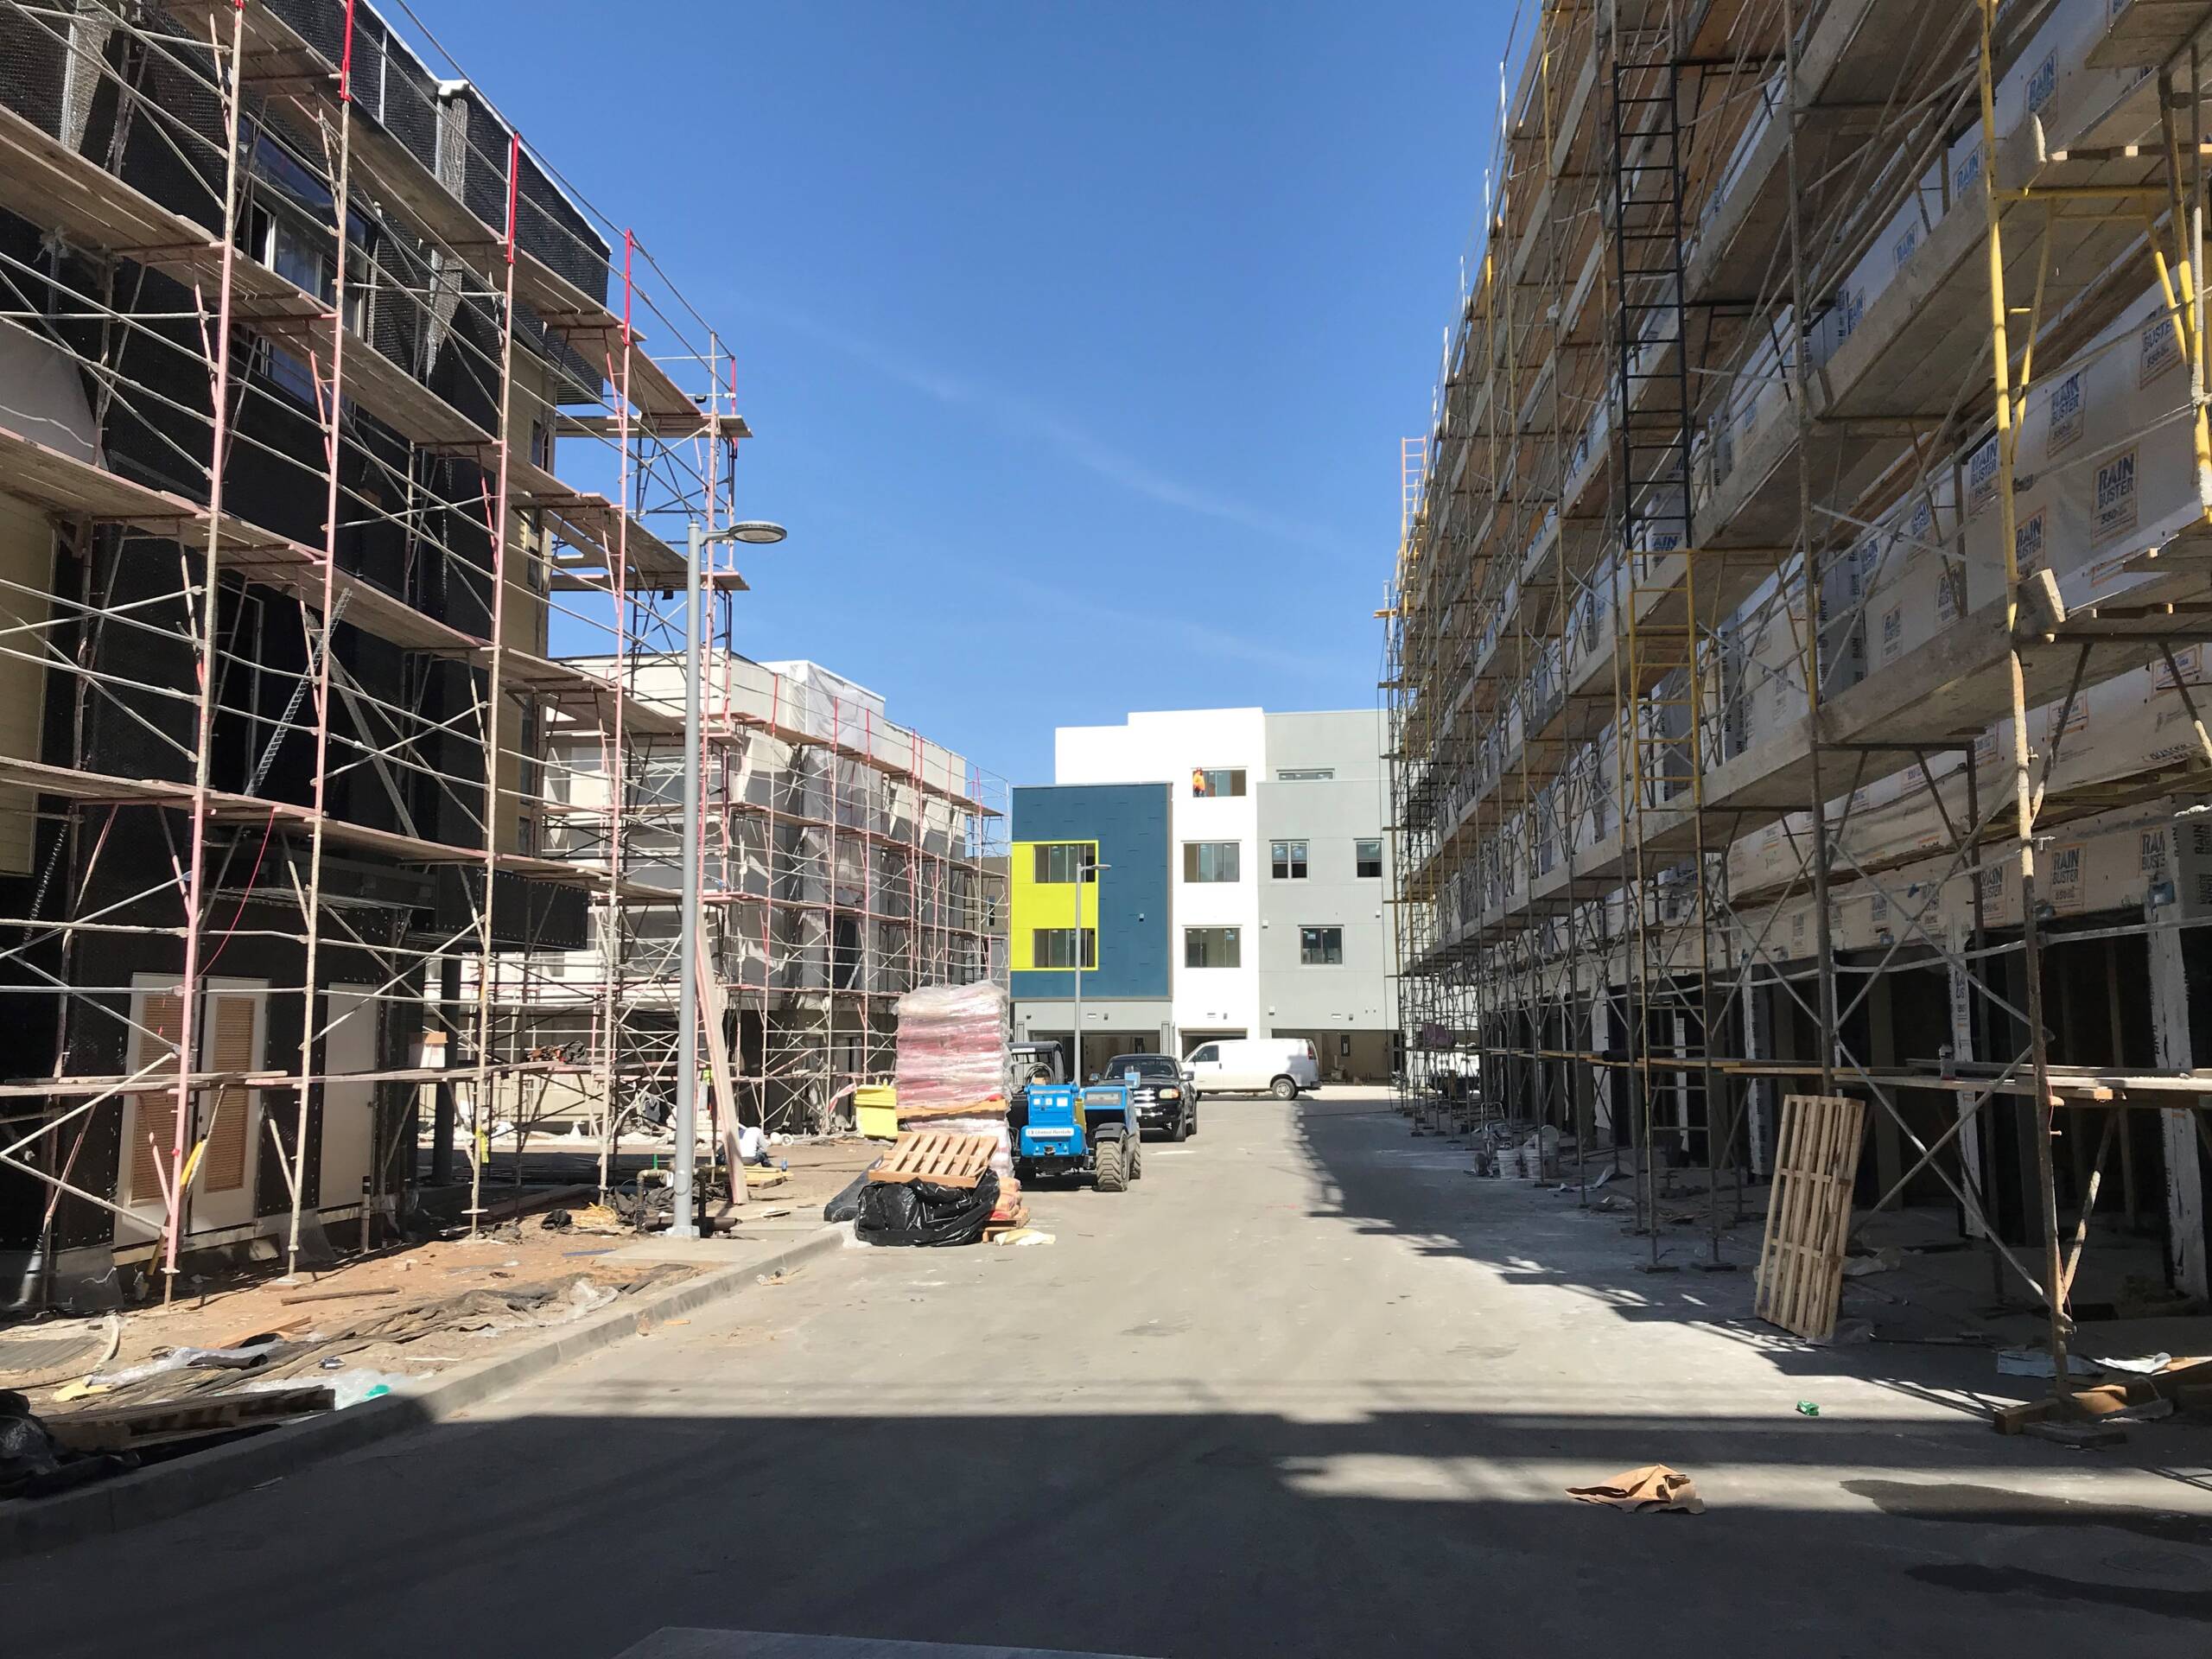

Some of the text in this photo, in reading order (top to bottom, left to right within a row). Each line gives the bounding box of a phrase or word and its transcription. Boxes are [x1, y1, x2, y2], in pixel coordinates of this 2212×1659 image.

[2099, 453, 2134, 494] RAIN
[2098, 476, 2134, 510] BUSTER
[2017, 514, 2043, 549] RAIN
[2052, 868, 2080, 886] BUSTER
[2054, 849, 2081, 871] RAIN
